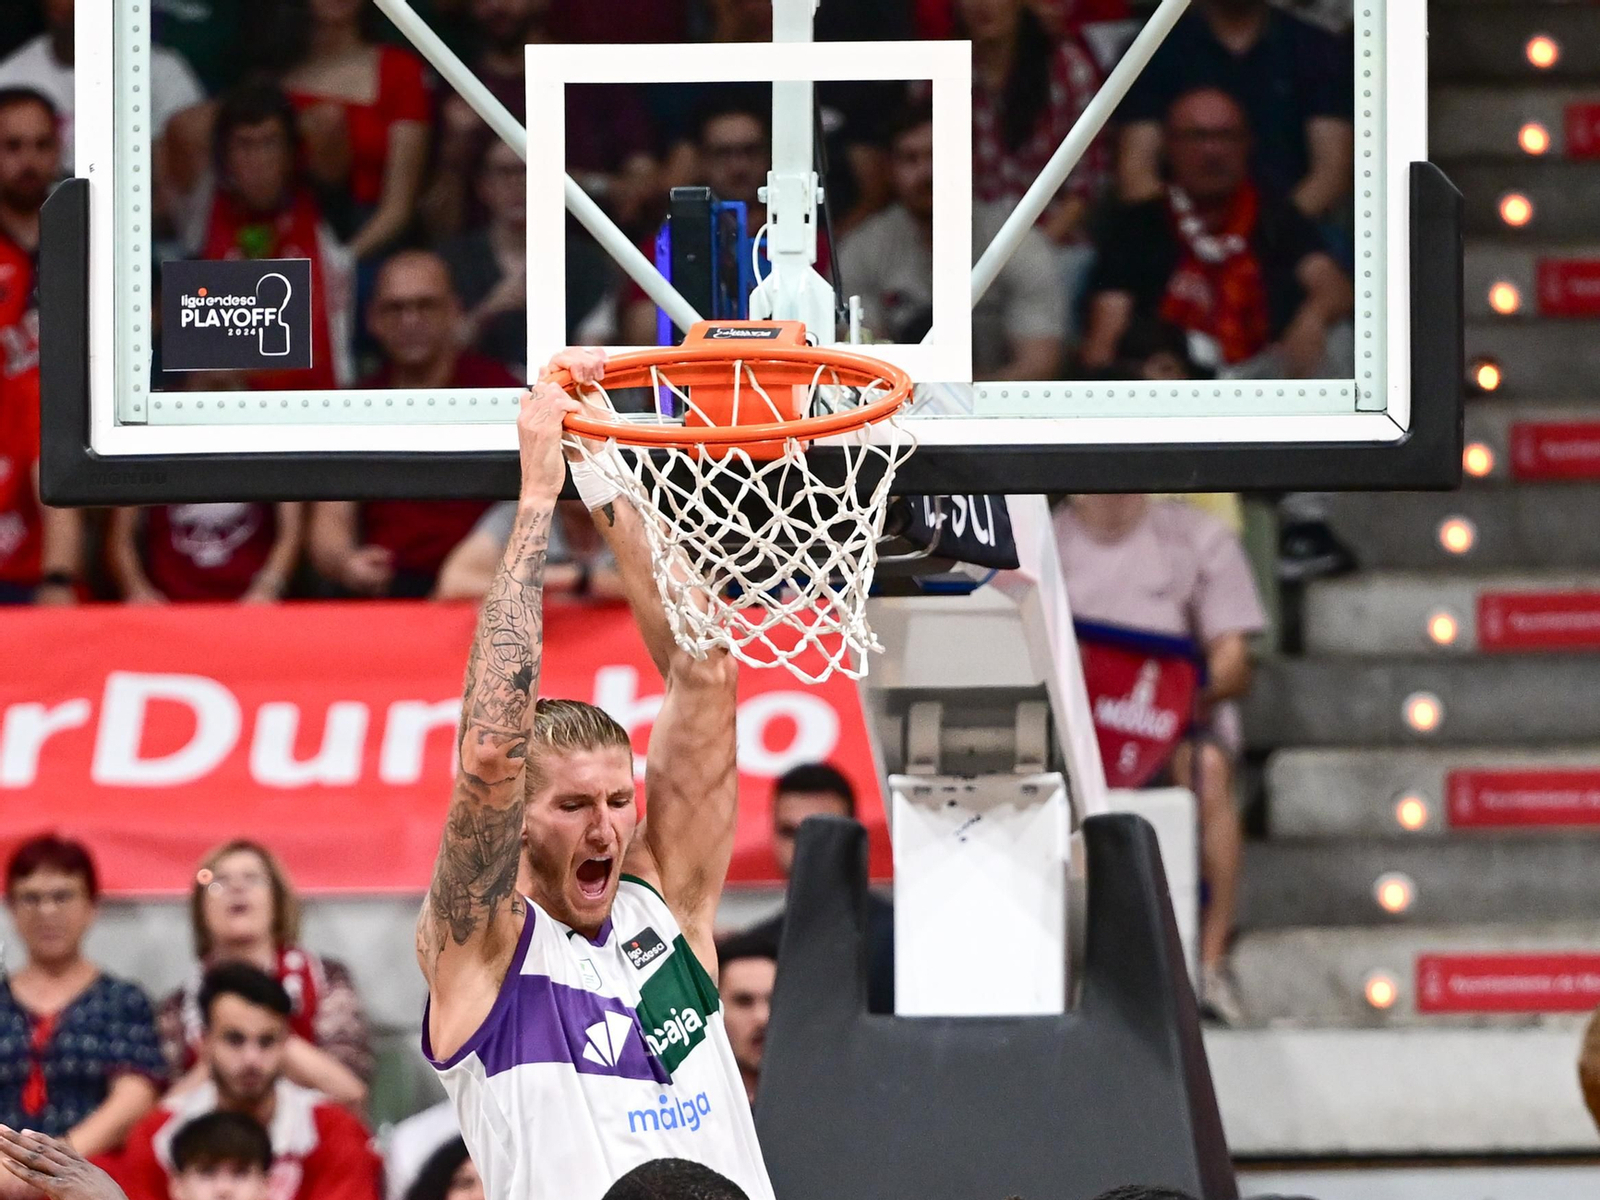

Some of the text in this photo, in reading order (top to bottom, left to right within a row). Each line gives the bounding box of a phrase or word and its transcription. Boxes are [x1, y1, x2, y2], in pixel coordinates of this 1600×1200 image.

[181, 294, 257, 308] liga endesa
[181, 308, 278, 328] PLAYOFF
[228, 328, 257, 336] 2024
[627, 946, 643, 961] liga
[633, 941, 666, 967] endesa
